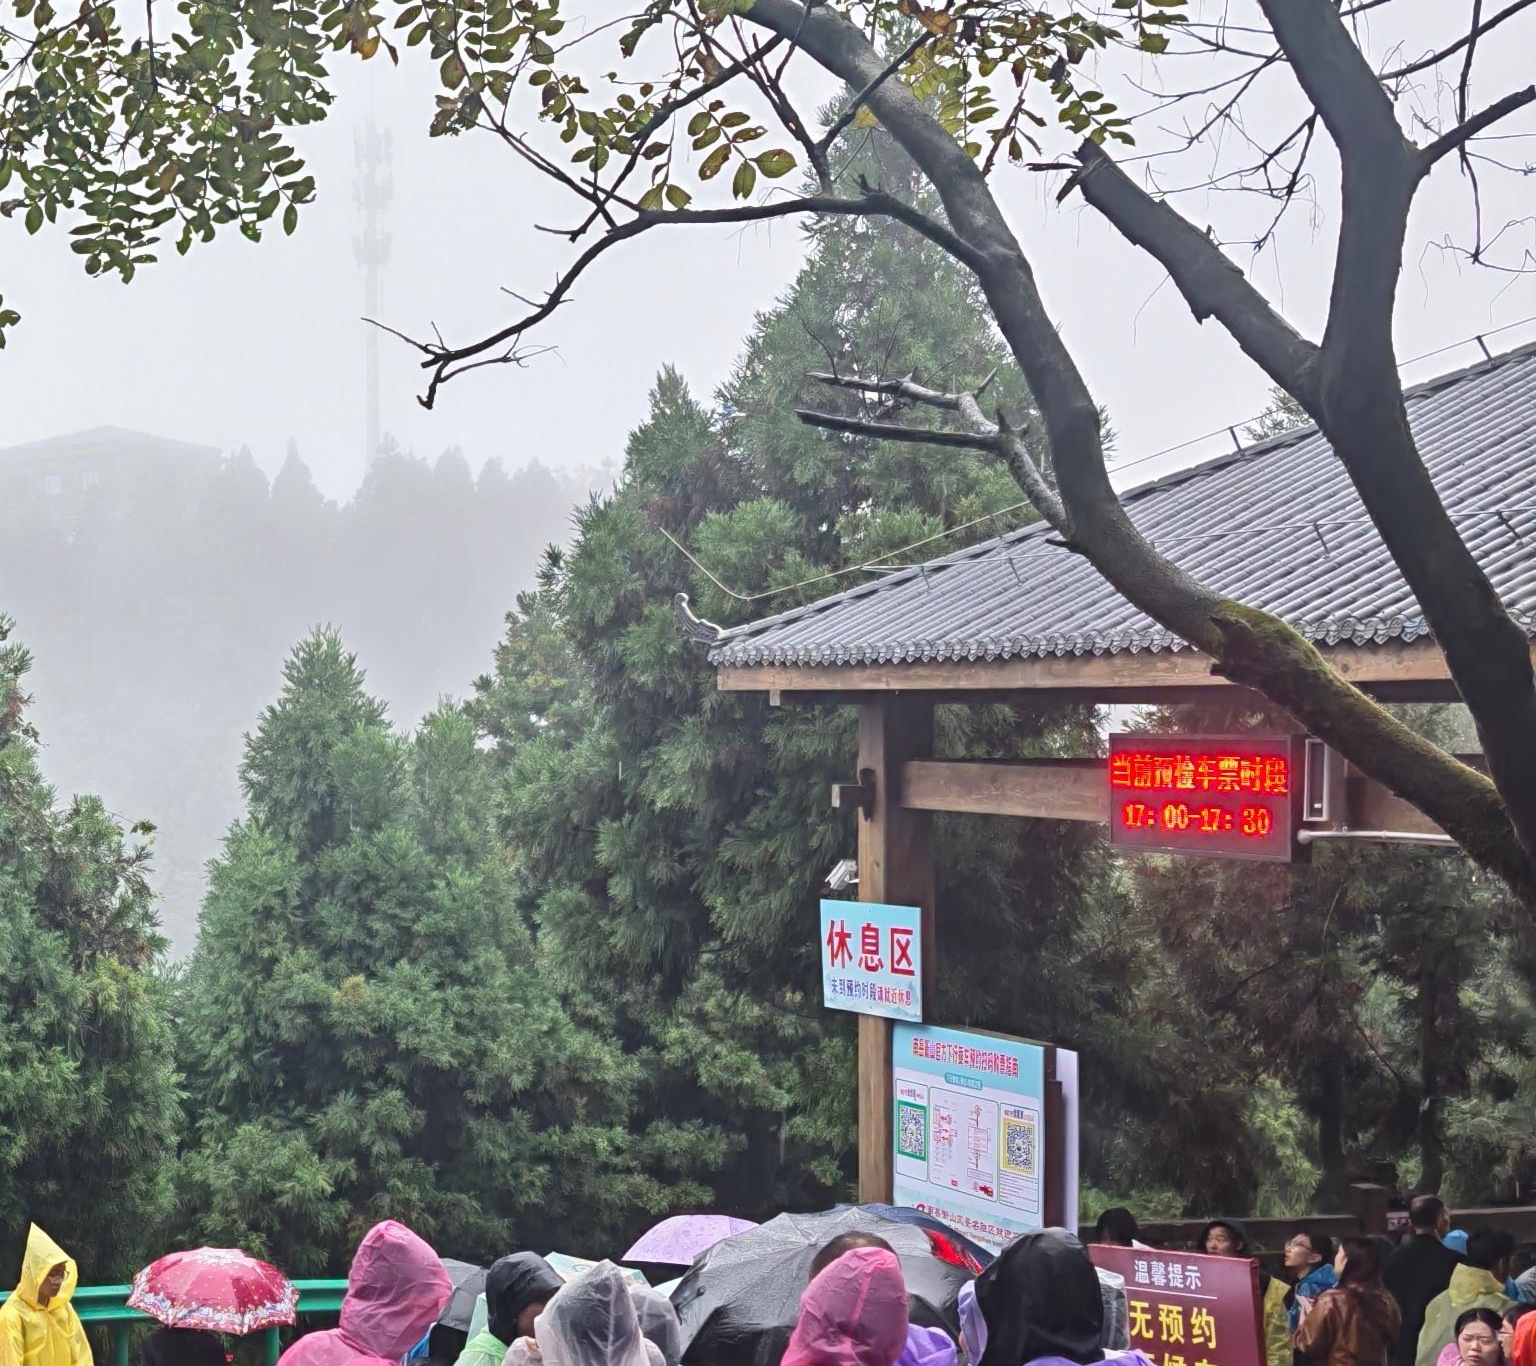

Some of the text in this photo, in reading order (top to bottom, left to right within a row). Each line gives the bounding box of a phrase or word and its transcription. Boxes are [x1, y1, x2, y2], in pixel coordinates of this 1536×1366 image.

[826, 918, 916, 977] 休息区
[1134, 1259, 1202, 1290] 温馨提示
[1129, 1300, 1217, 1350] 无预约
